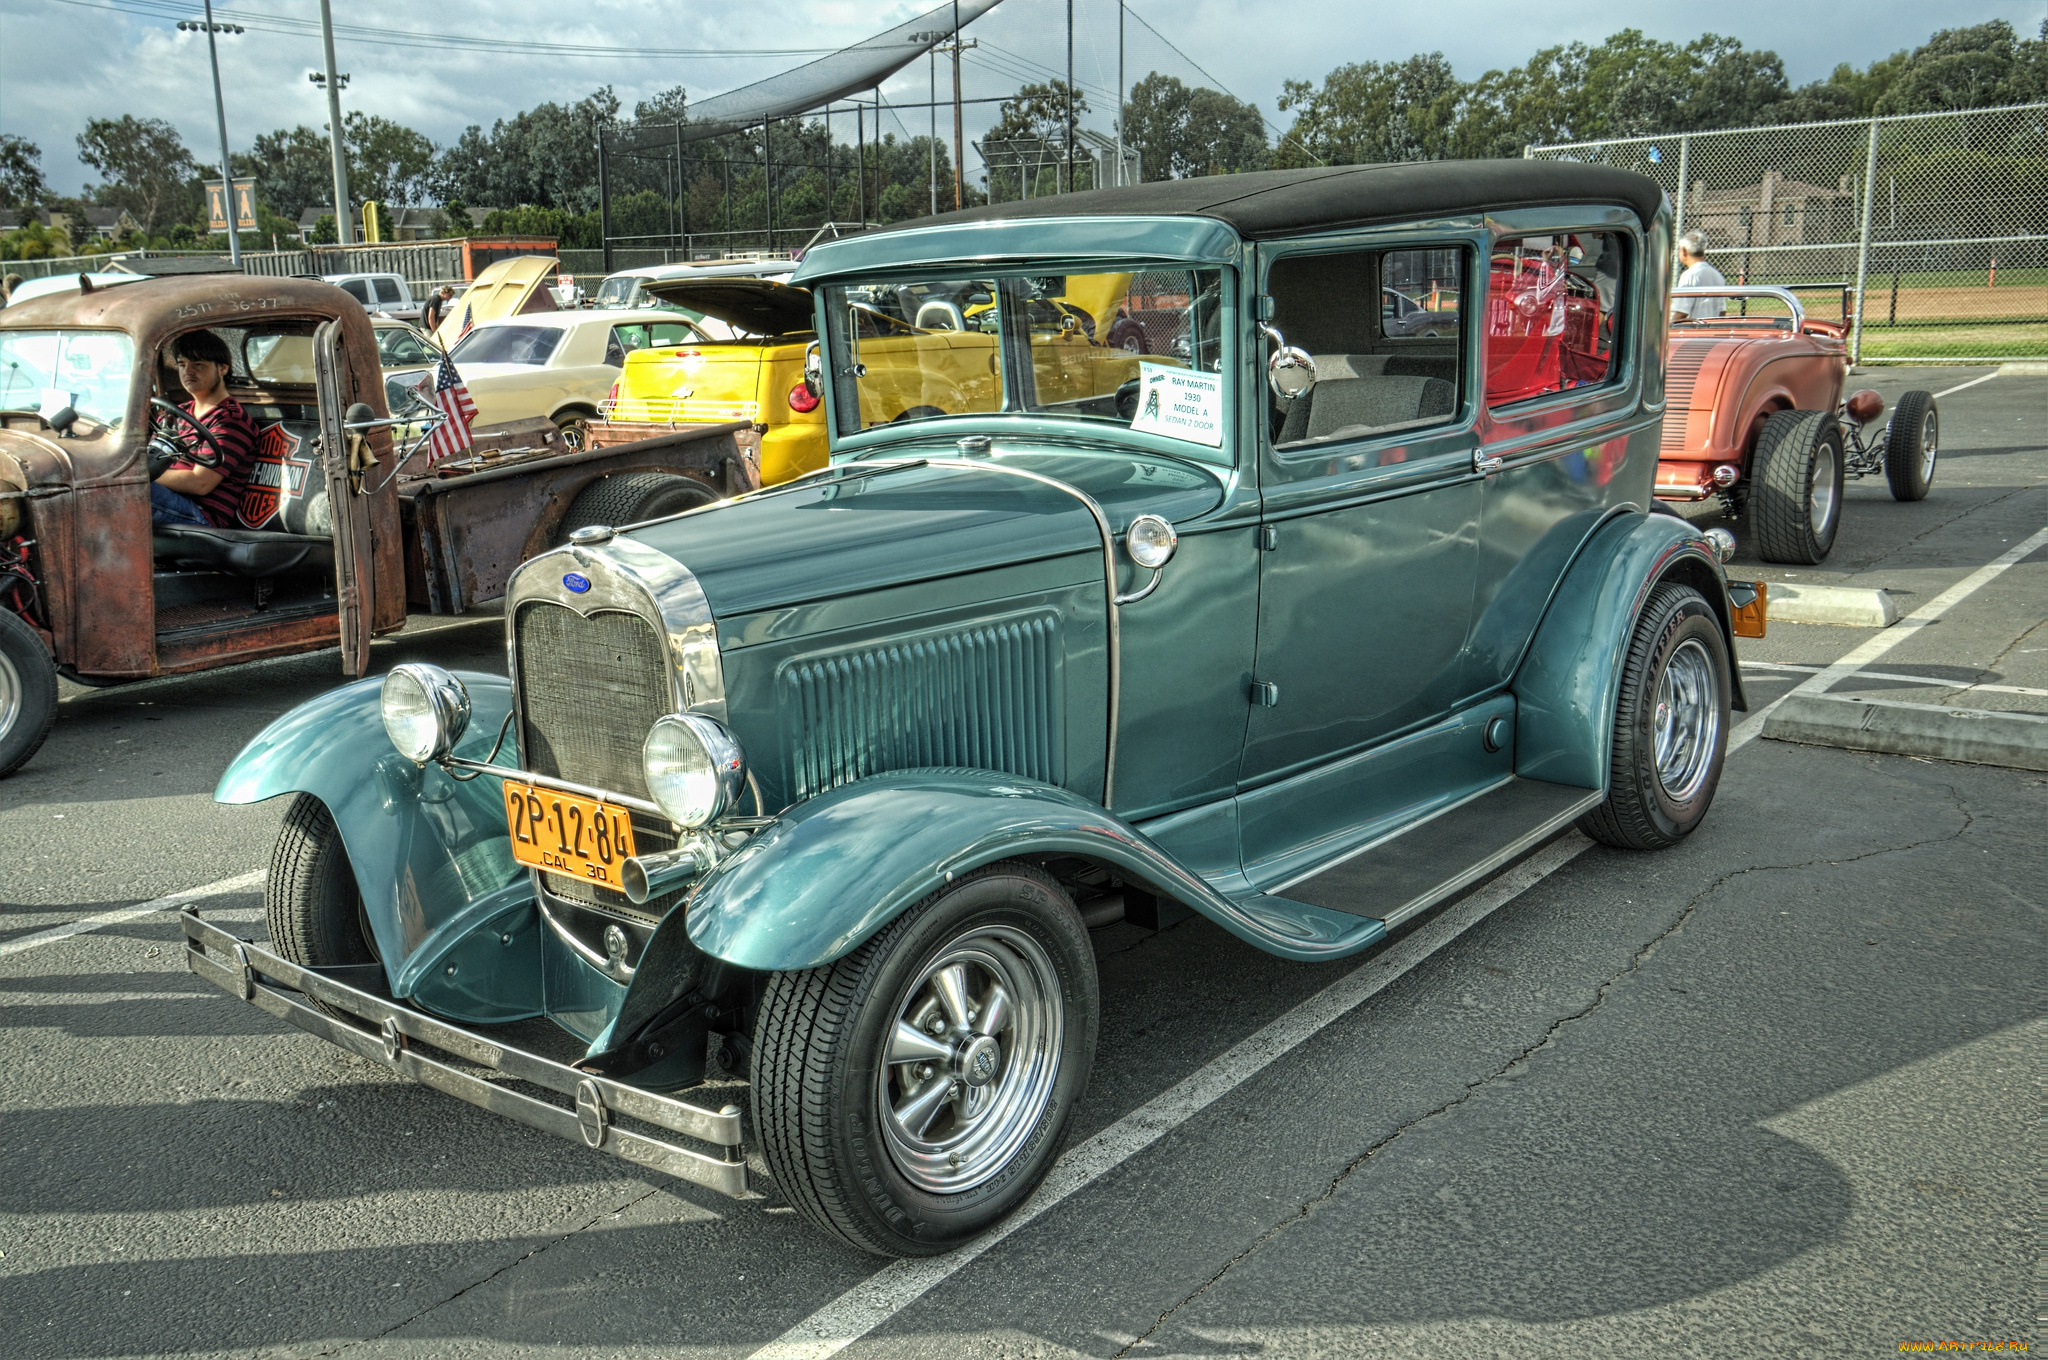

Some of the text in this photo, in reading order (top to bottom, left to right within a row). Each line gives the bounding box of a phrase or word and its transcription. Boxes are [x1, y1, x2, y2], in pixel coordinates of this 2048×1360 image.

[1171, 377, 1216, 392] RAY MARTIN
[1184, 392, 1202, 403] 1930
[1173, 403, 1209, 417] MODEL A
[1164, 415, 1214, 431] SEDAN 2 DOOR
[260, 429, 291, 458] OTOR
[565, 574, 586, 589] Ford
[543, 851, 607, 881] CAL 30
[1020, 883, 1049, 904] SP
[848, 1113, 906, 1223] DUNLOP
